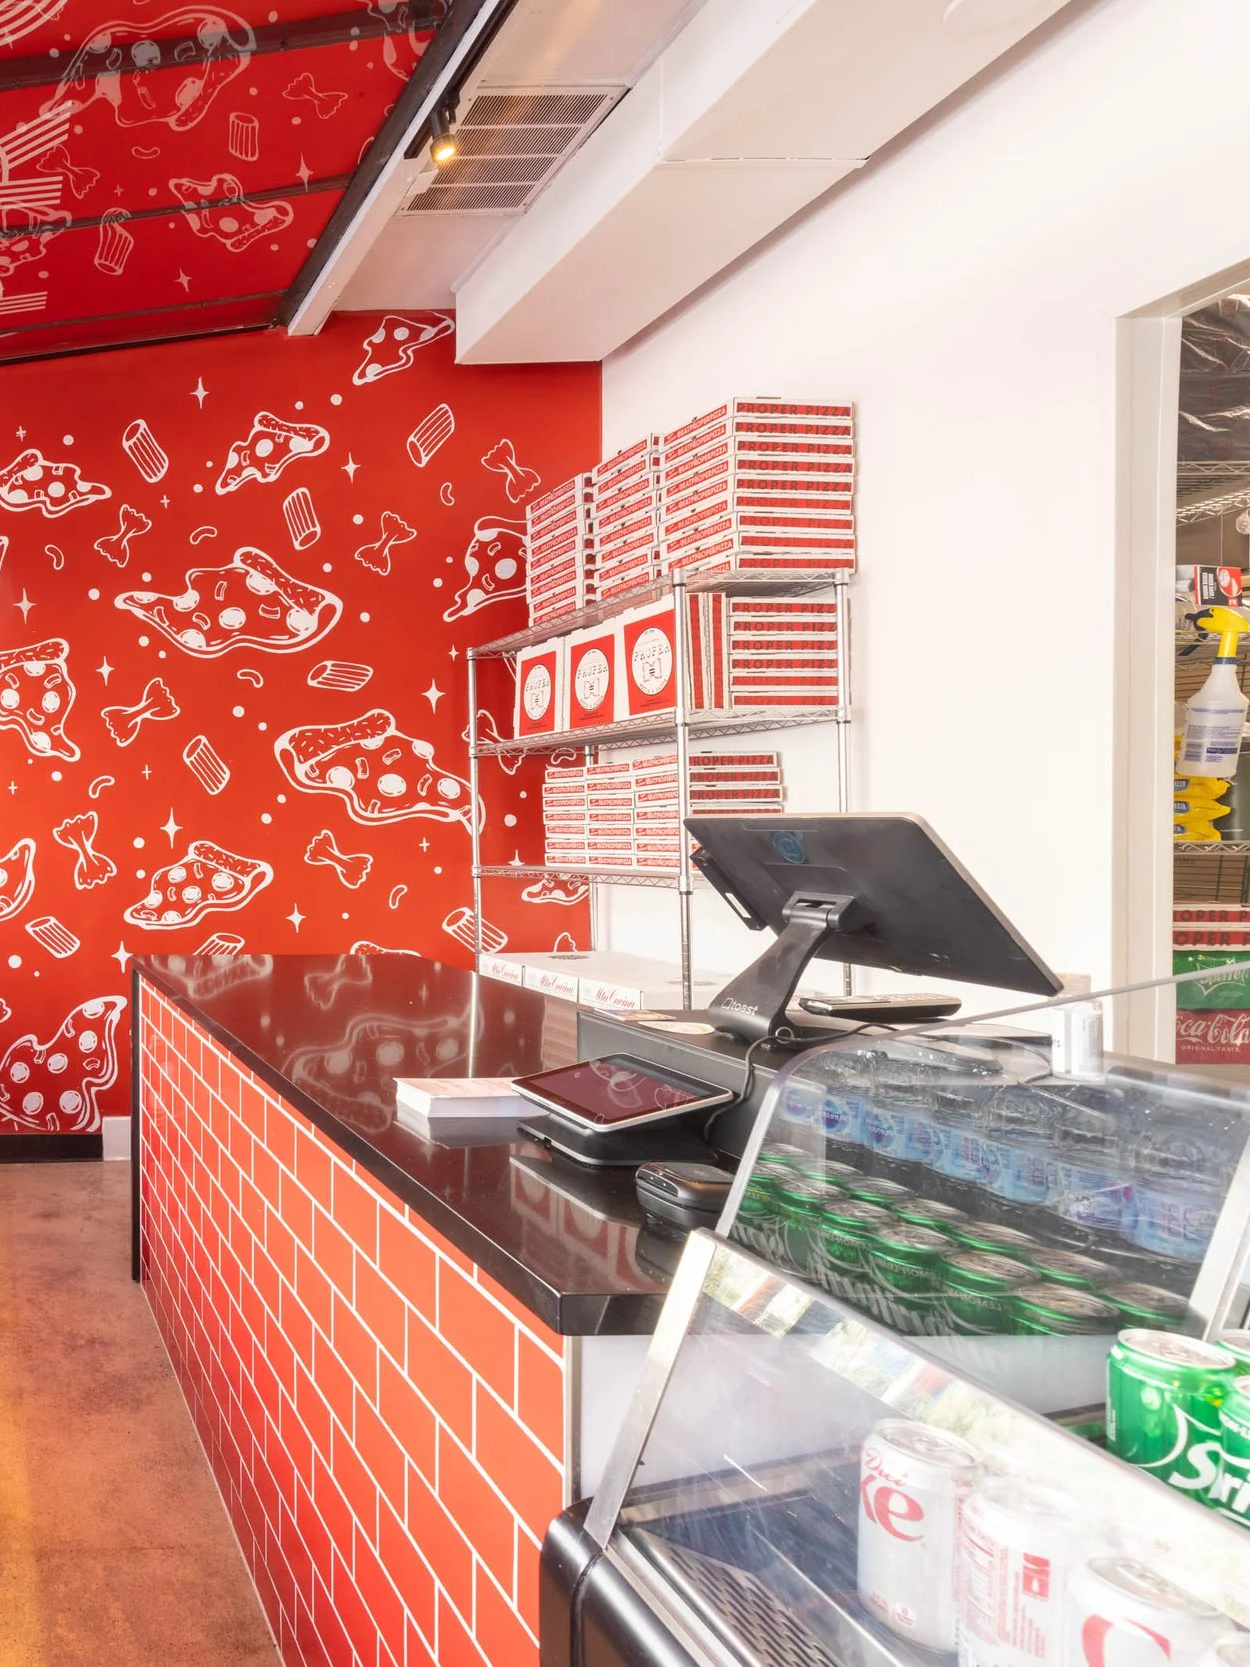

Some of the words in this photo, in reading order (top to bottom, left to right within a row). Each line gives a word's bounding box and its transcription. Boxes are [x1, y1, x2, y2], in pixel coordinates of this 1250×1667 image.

[736, 402, 797, 414] PROPER
[806, 405, 850, 416] PIZZA
[735, 422, 797, 434] PROPER
[805, 425, 850, 436] PIZZA
[738, 441, 798, 453] PROPER
[807, 444, 852, 455] PIZZA
[738, 460, 798, 472] PROPER
[807, 463, 852, 474] PIZZA
[737, 479, 797, 491] PROPER
[806, 482, 851, 493] PIZZA
[732, 602, 792, 614] PROPER
[801, 602, 835, 614] PIZZ
[734, 622, 793, 632] PROPER
[803, 622, 835, 632] PIZZ
[732, 640, 792, 651] PROPER
[802, 640, 835, 651] PIZZ
[732, 659, 792, 670] PROPER
[802, 659, 835, 670] PIZZ
[690, 756, 734, 767] ROPER
[739, 755, 774, 766] PIZZA
[1174, 931, 1230, 945] OPER
[731, 998, 759, 1016] toast
